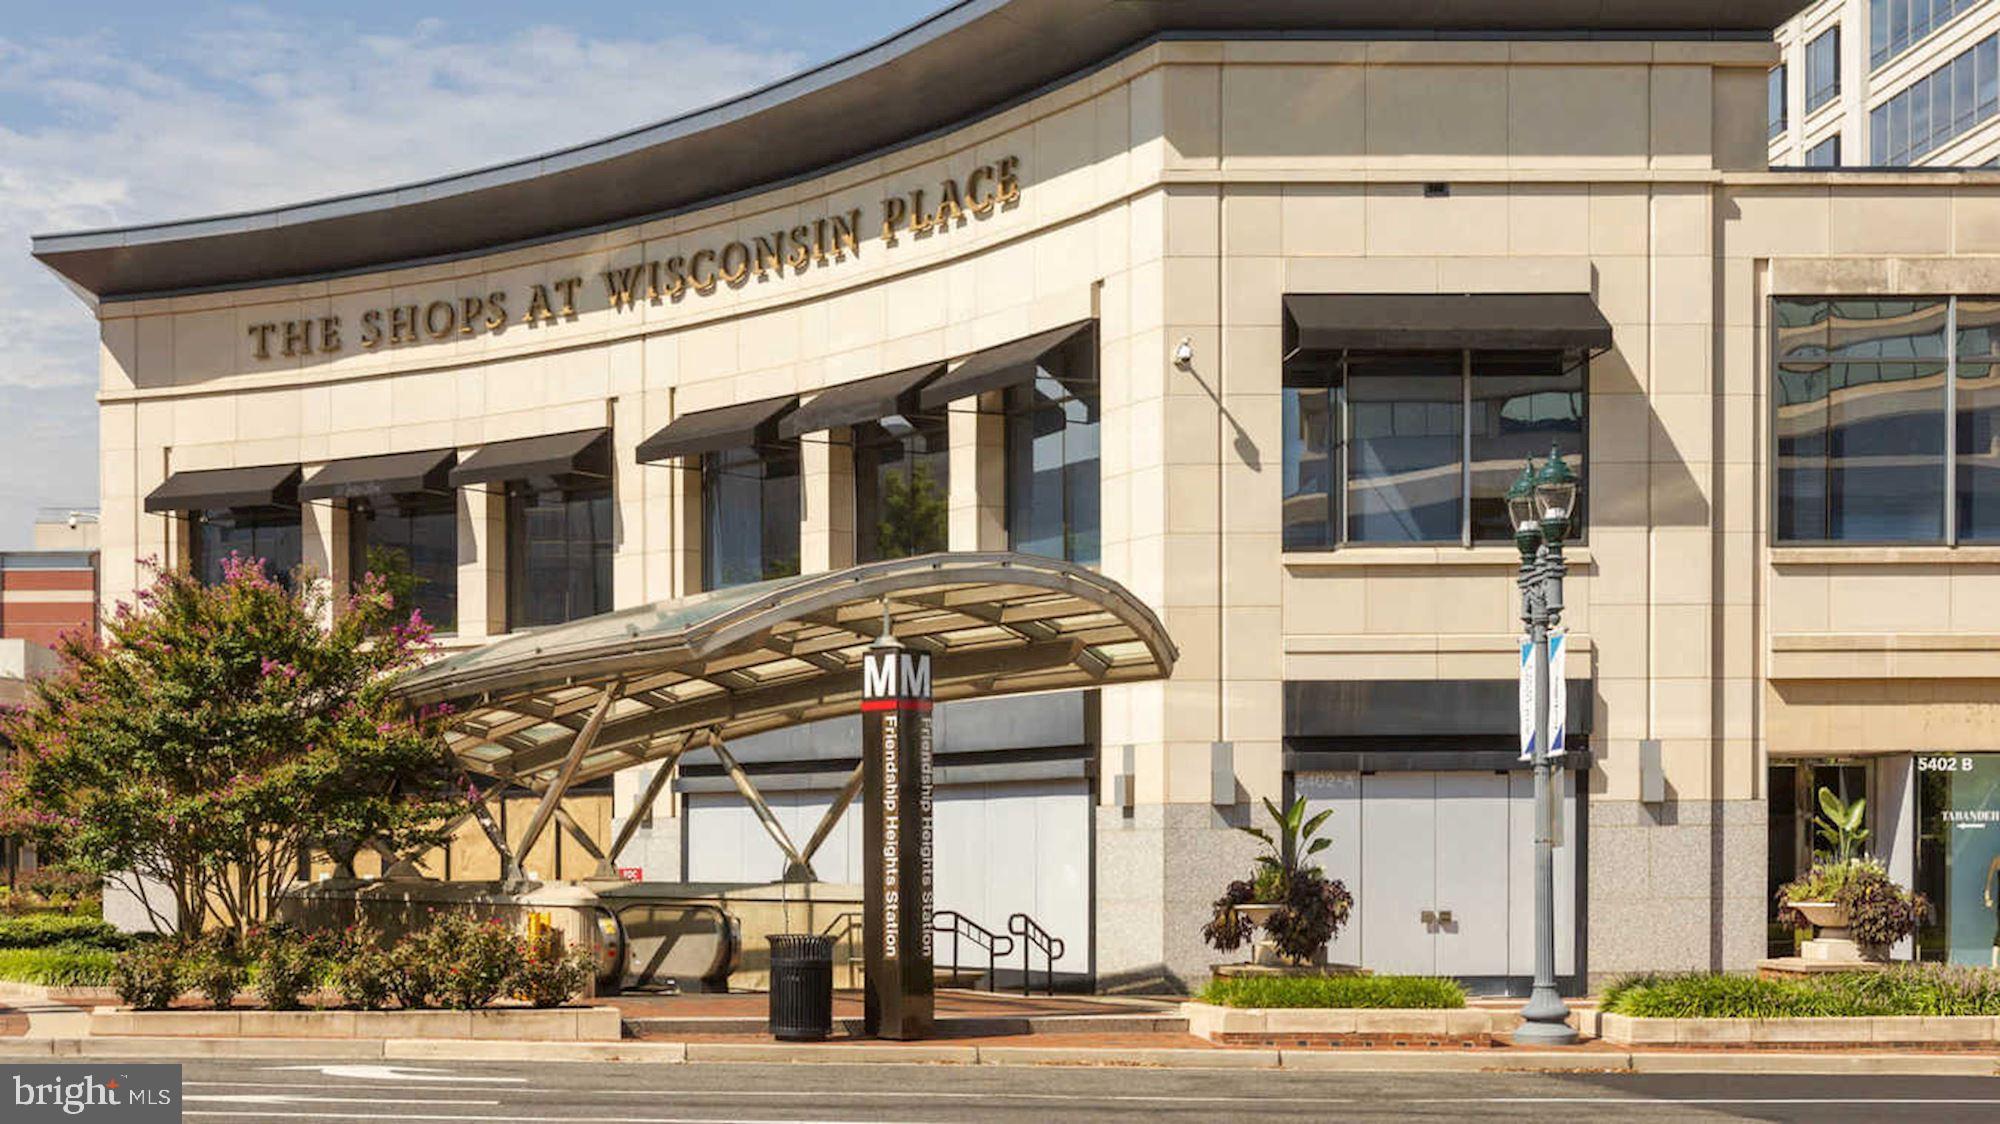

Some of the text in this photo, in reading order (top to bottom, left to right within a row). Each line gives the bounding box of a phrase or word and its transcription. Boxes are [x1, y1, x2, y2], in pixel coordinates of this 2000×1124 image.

[248, 154, 1021, 359] THE SHOPS AT WISCONSIN PLACE
[863, 653, 897, 698] M
[900, 654, 931, 698] M
[1918, 757, 1973, 771] 5402 B
[883, 715, 899, 957] Friendship Heights Station
[920, 717, 933, 957] Friendship Heights Station
